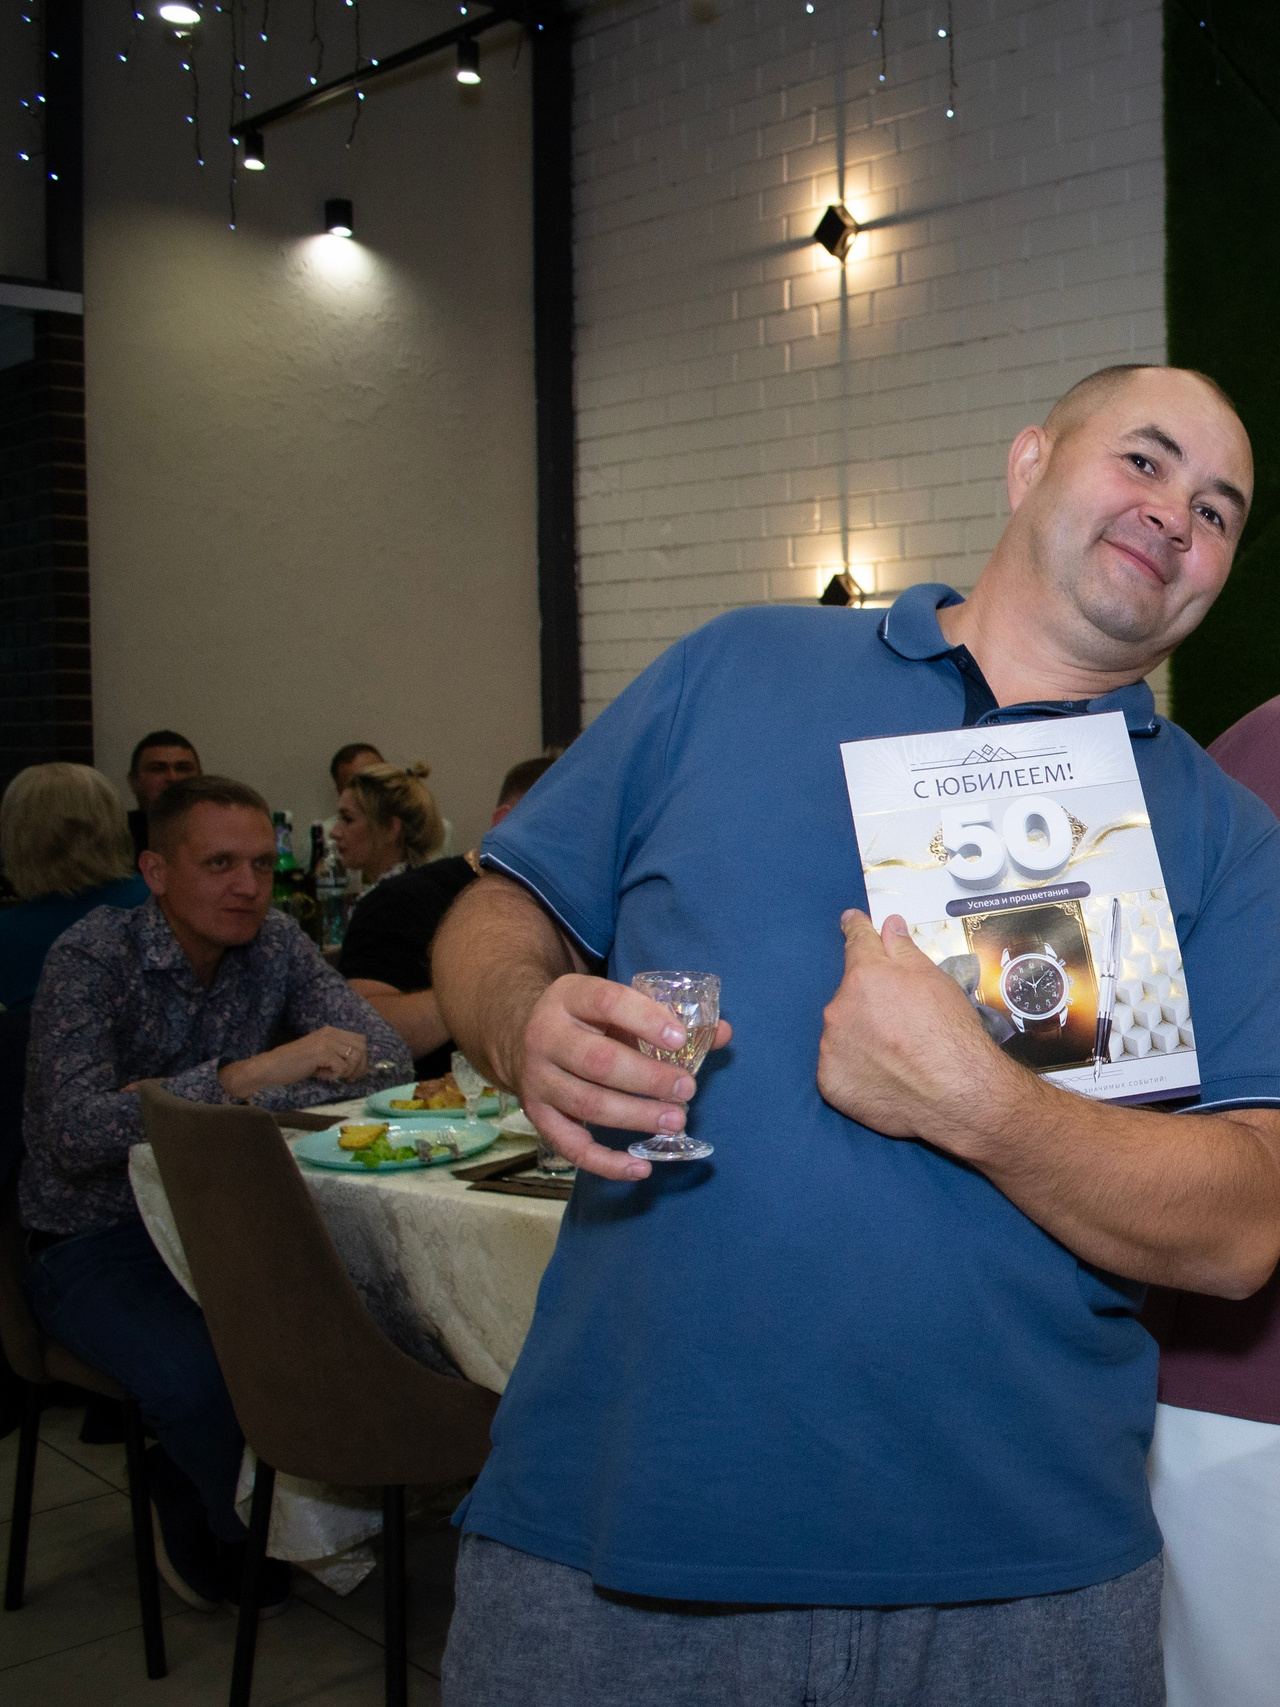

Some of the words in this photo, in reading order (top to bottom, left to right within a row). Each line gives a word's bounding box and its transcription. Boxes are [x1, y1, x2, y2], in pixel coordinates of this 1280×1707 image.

[913, 780, 930, 799] С
[935, 763, 1074, 797] ЮБИЛЕЕМ!
[940, 796, 1073, 890] 50
[967, 897, 1000, 909] Успеха
[1002, 896, 1008, 904] и
[1009, 888, 1069, 904] процветания
[1128, 1076, 1168, 1087] СОБЫТИЙ!
